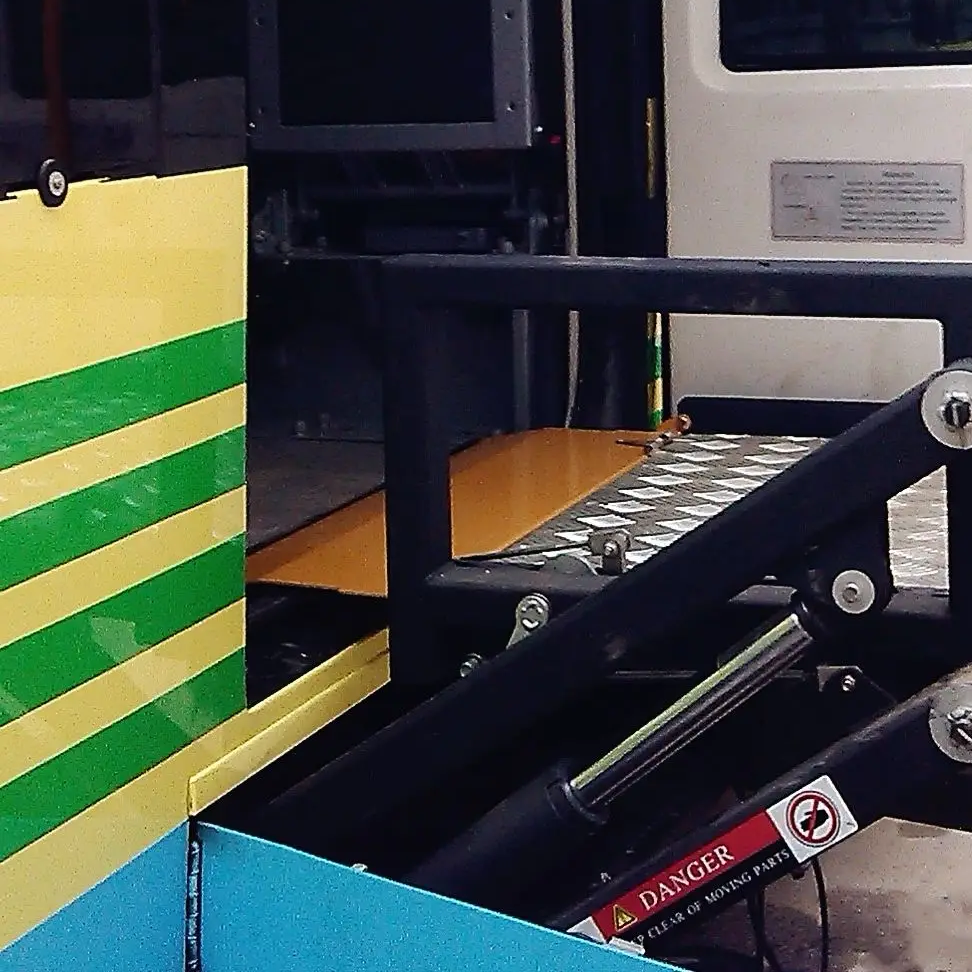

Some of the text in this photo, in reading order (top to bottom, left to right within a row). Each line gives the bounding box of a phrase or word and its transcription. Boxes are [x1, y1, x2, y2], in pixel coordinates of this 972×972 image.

[638, 845, 734, 909] DANGER
[648, 849, 789, 938] CLEAR OF MOVING PARTS
